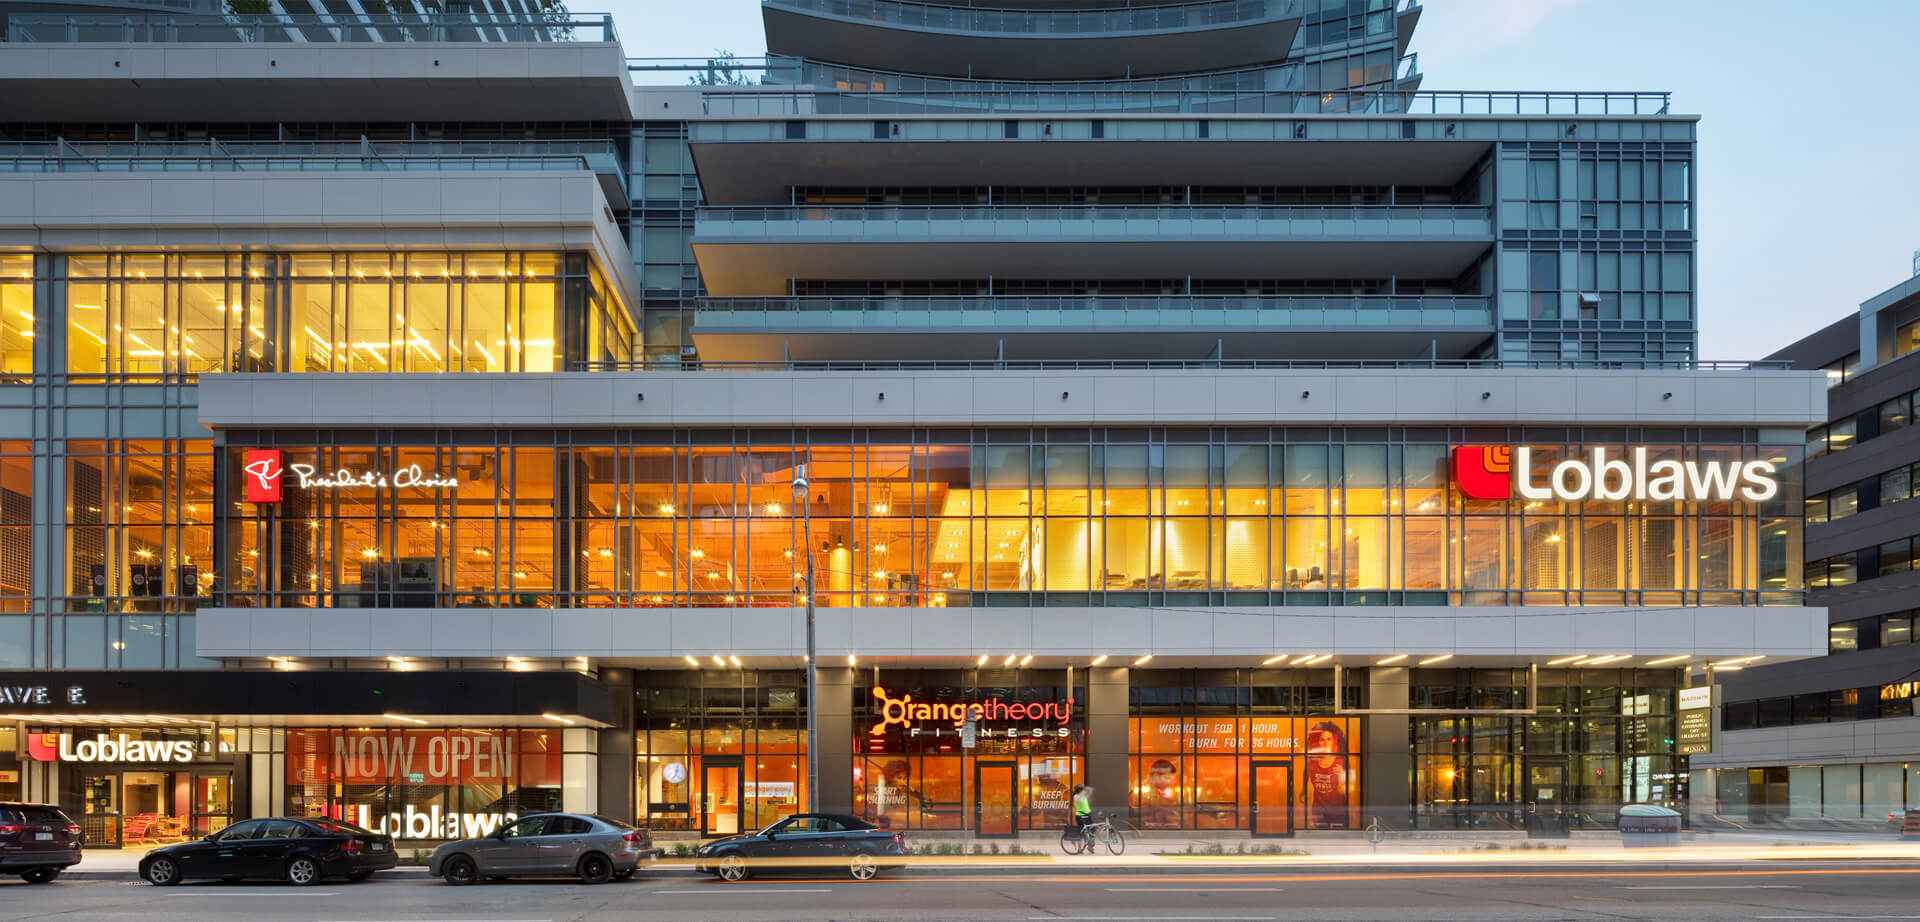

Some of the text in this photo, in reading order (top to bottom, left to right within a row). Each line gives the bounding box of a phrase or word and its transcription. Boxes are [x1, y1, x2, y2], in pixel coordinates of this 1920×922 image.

[290, 463, 458, 488] President's Choice
[1518, 447, 1778, 500] Loblaws
[911, 727, 1070, 738] FITNESS
[1159, 723, 1280, 734] WORKOUT FOR 1 HOUR.
[59, 734, 193, 762] Loblaws
[1188, 737, 1219, 748] BURN
[1224, 737, 1245, 748] FOR
[1252, 738, 1264, 748] 36
[335, 736, 512, 778] NOW OPEN
[1041, 790, 1062, 800] KEEP
[1033, 800, 1070, 809] BURNING
